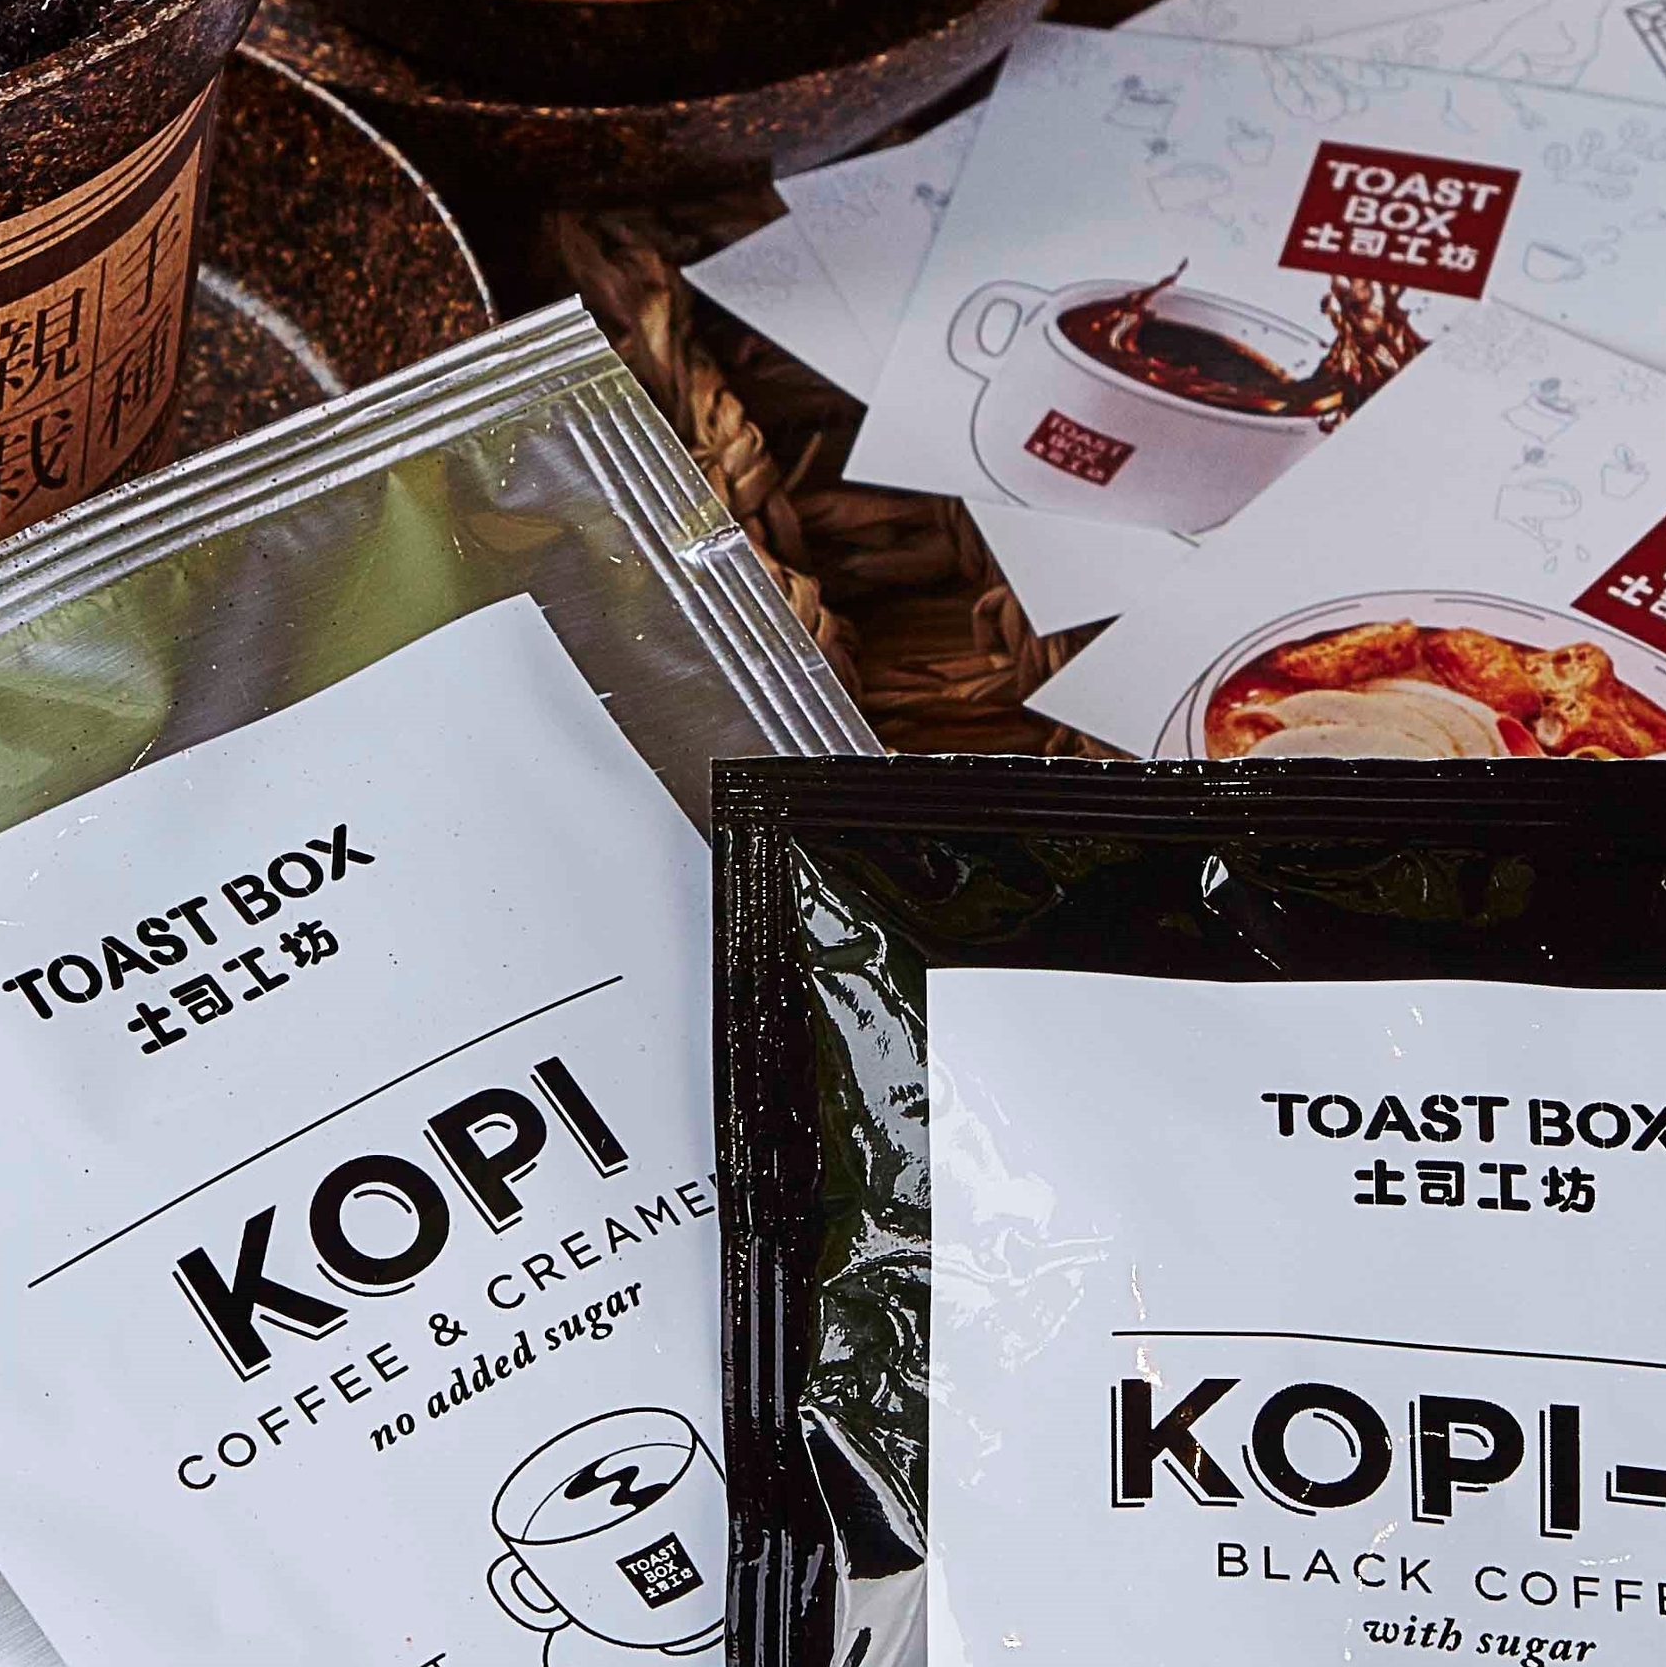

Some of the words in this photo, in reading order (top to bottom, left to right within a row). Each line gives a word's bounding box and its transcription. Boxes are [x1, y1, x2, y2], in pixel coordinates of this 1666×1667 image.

[1326, 159, 1501, 212] TOAST
[1342, 194, 1458, 238] BOX
[1301, 221, 1480, 273] 土司工坊
[2, 895, 218, 1021] TOAST
[223, 823, 376, 927] BOX
[126, 917, 342, 1056] 土司工坊
[1262, 1091, 1510, 1146] TOAST
[1352, 1157, 1598, 1214] 土司工坊
[171, 1055, 630, 1384] KOPI
[177, 1343, 412, 1492] COFFEE
[431, 1310, 470, 1346] &
[487, 1172, 717, 1312] CREAME
[369, 1413, 417, 1454] no
[427, 1336, 536, 1421] added
[547, 1282, 645, 1357] sugar
[625, 1541, 678, 1576] TOAST
[643, 1559, 680, 1584] BOX
[1216, 1540, 1433, 1594] BLACK
[1363, 1615, 1463, 1652] with
[1475, 1631, 1598, 1667] sugar
